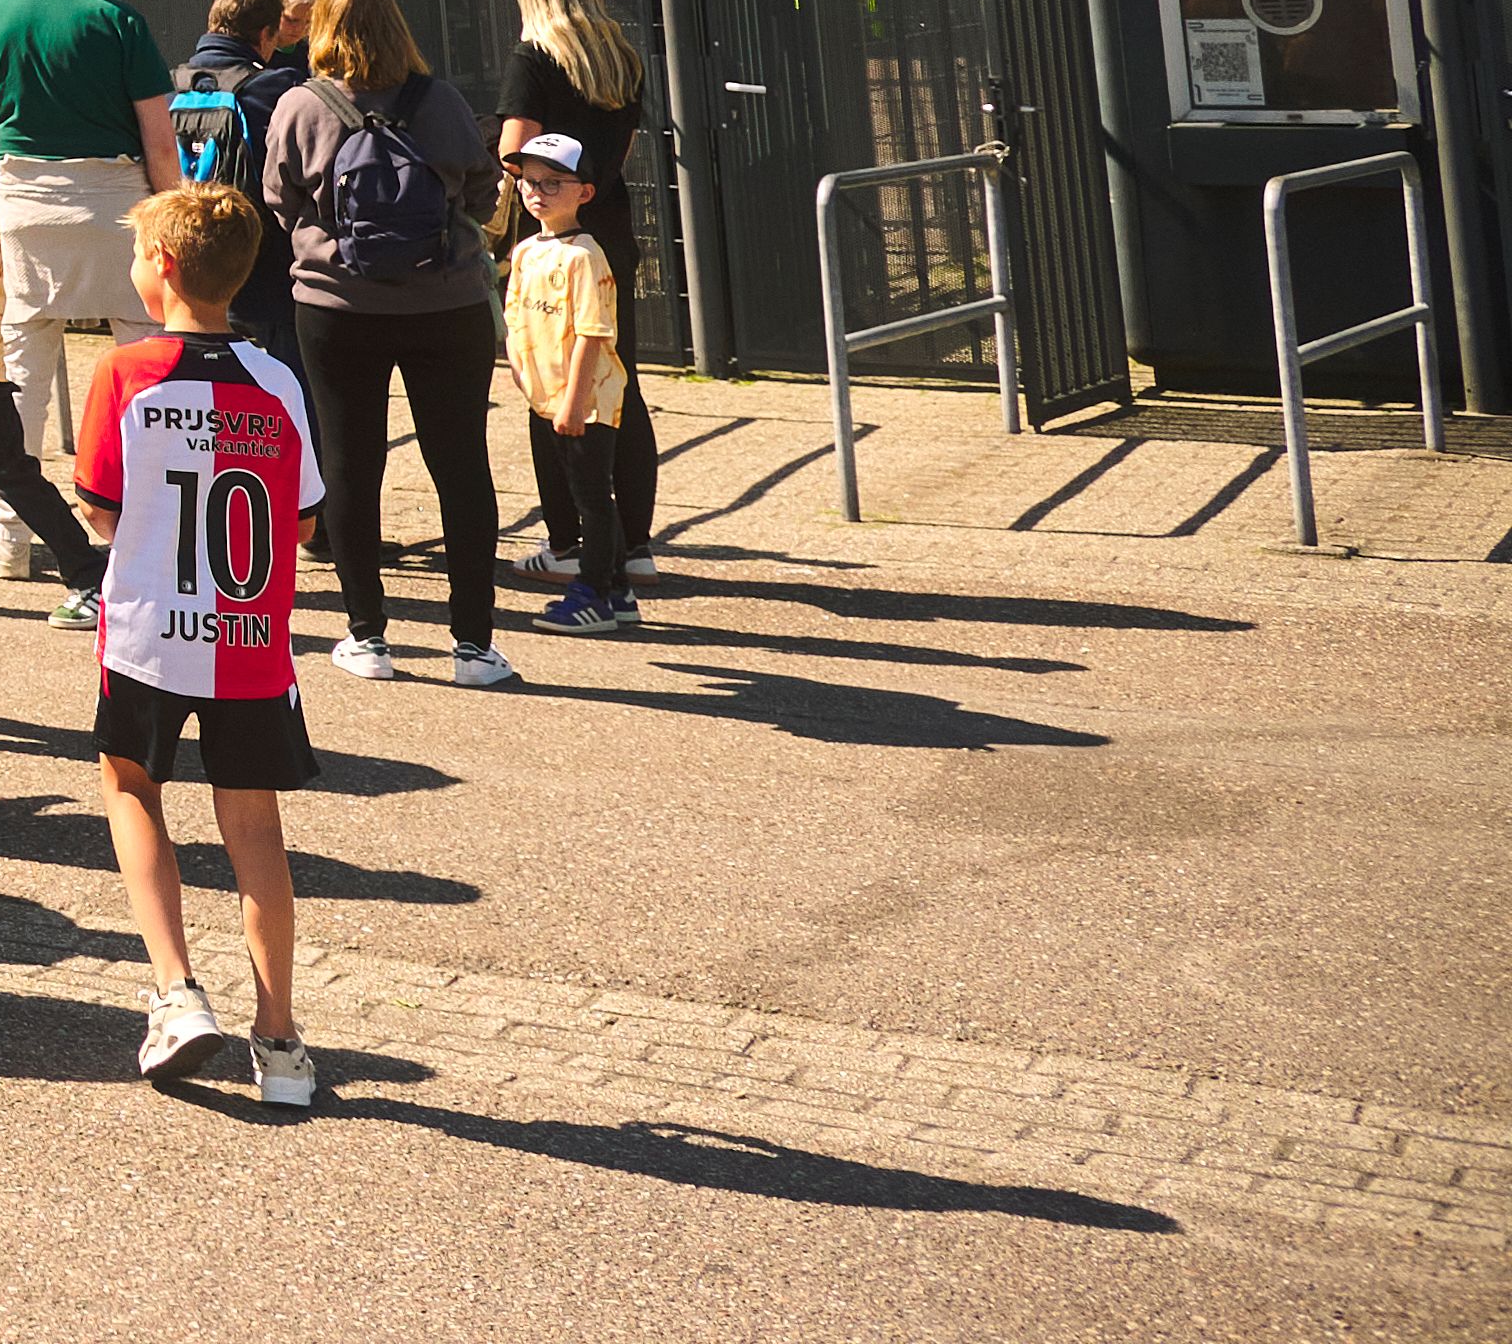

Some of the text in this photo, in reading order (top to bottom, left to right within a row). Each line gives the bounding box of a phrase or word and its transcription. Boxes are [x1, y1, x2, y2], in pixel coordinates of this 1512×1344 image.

[186, 435, 281, 458] vakanties
[165, 468, 273, 602] 10
[161, 610, 271, 648] JUSTIN
